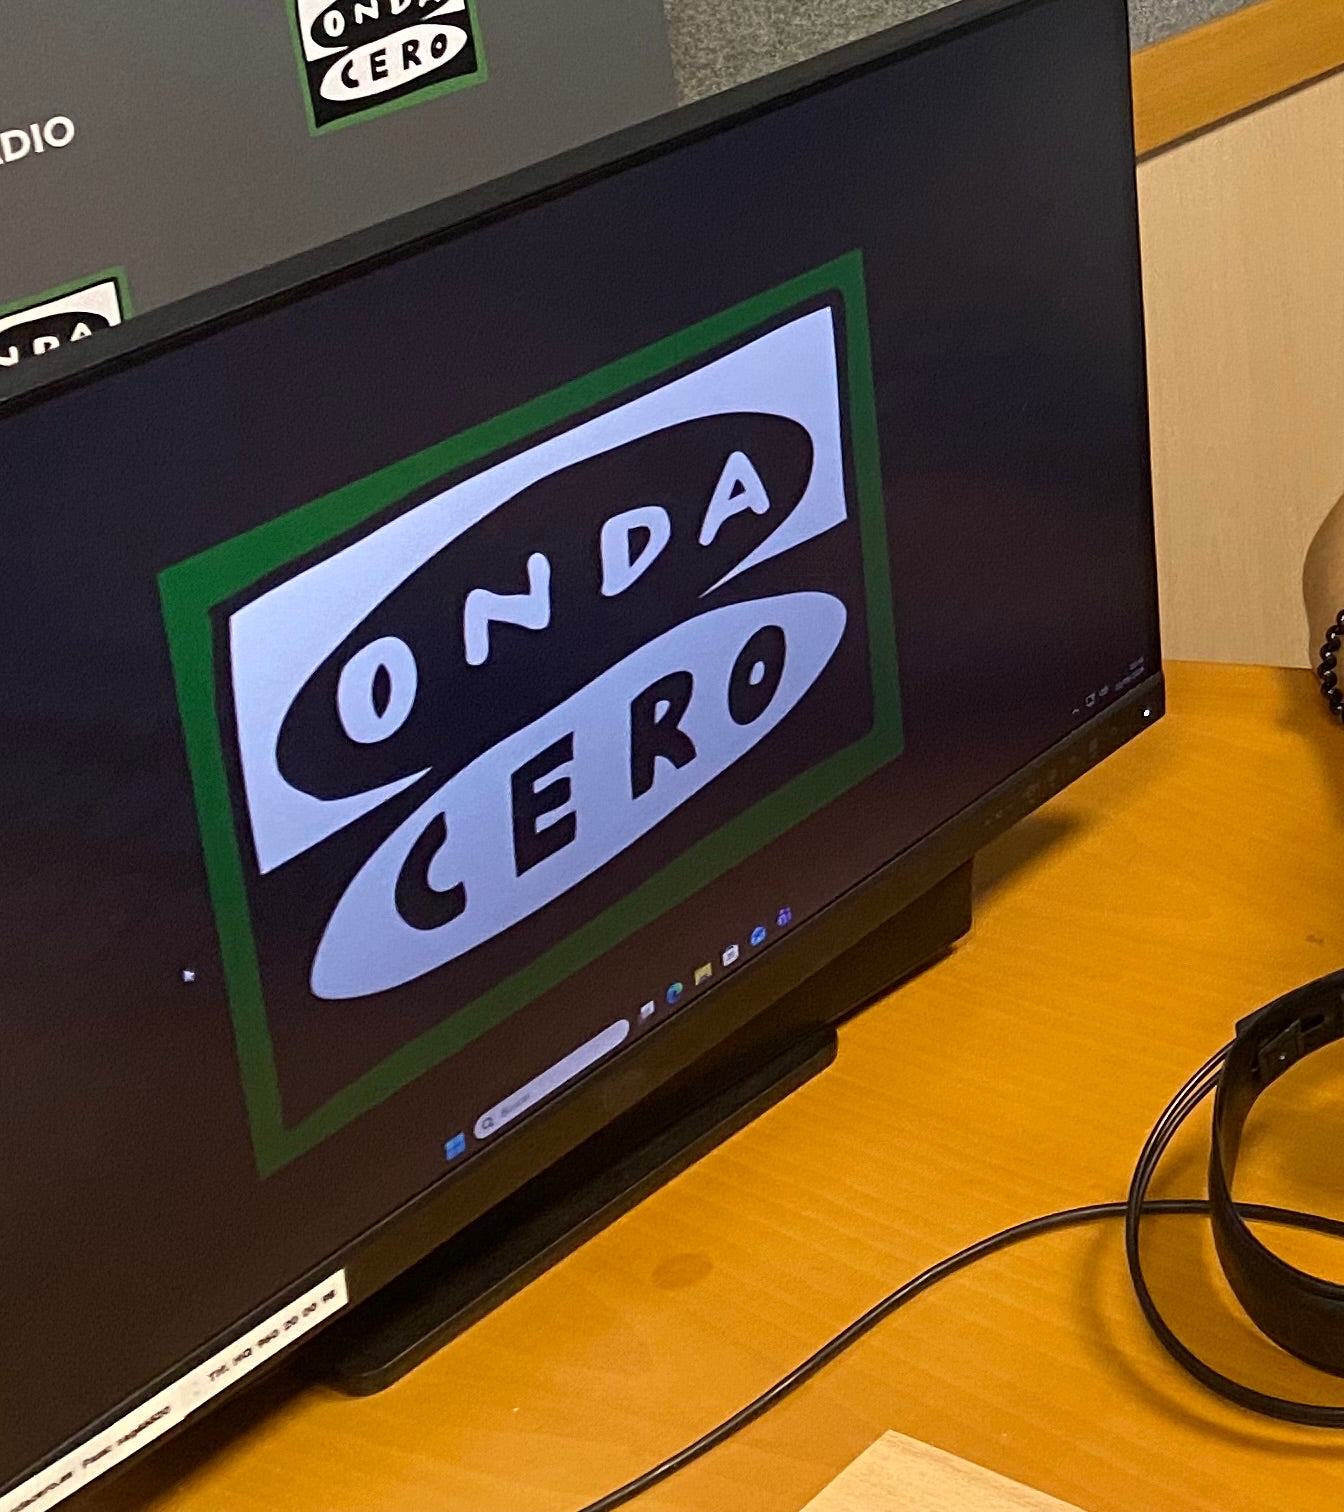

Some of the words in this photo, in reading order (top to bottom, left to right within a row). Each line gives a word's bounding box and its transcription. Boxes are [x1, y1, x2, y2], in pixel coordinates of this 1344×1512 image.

[0, 115, 76, 166] DIO
[340, 33, 448, 89] CERO
[335, 450, 771, 745] ONDA
[393, 623, 788, 932] CERO
